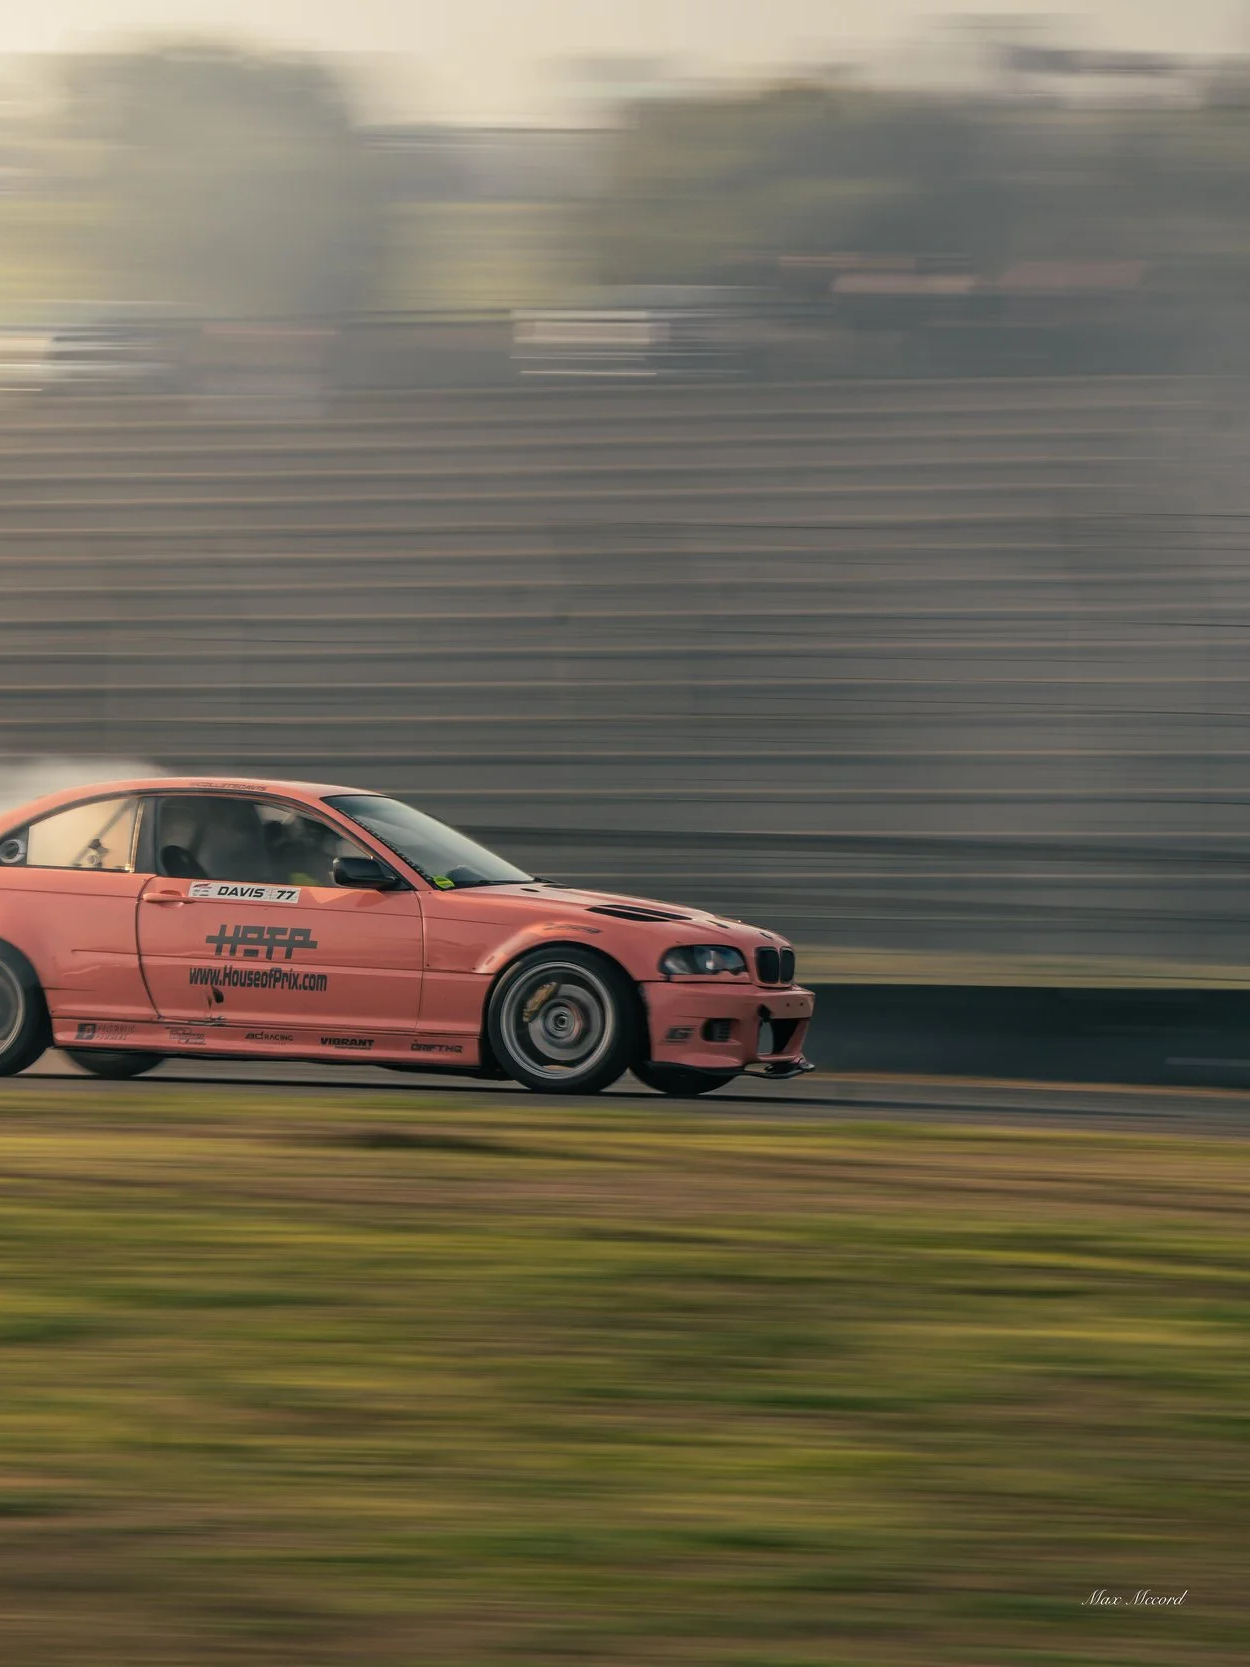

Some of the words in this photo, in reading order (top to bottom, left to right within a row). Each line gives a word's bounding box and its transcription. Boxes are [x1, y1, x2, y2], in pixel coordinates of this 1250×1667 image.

[217, 886, 265, 898] DAVIS
[276, 890, 296, 900] 77
[189, 965, 327, 991] www.HouseofPrix.com
[320, 1036, 375, 1047] VIBRANT
